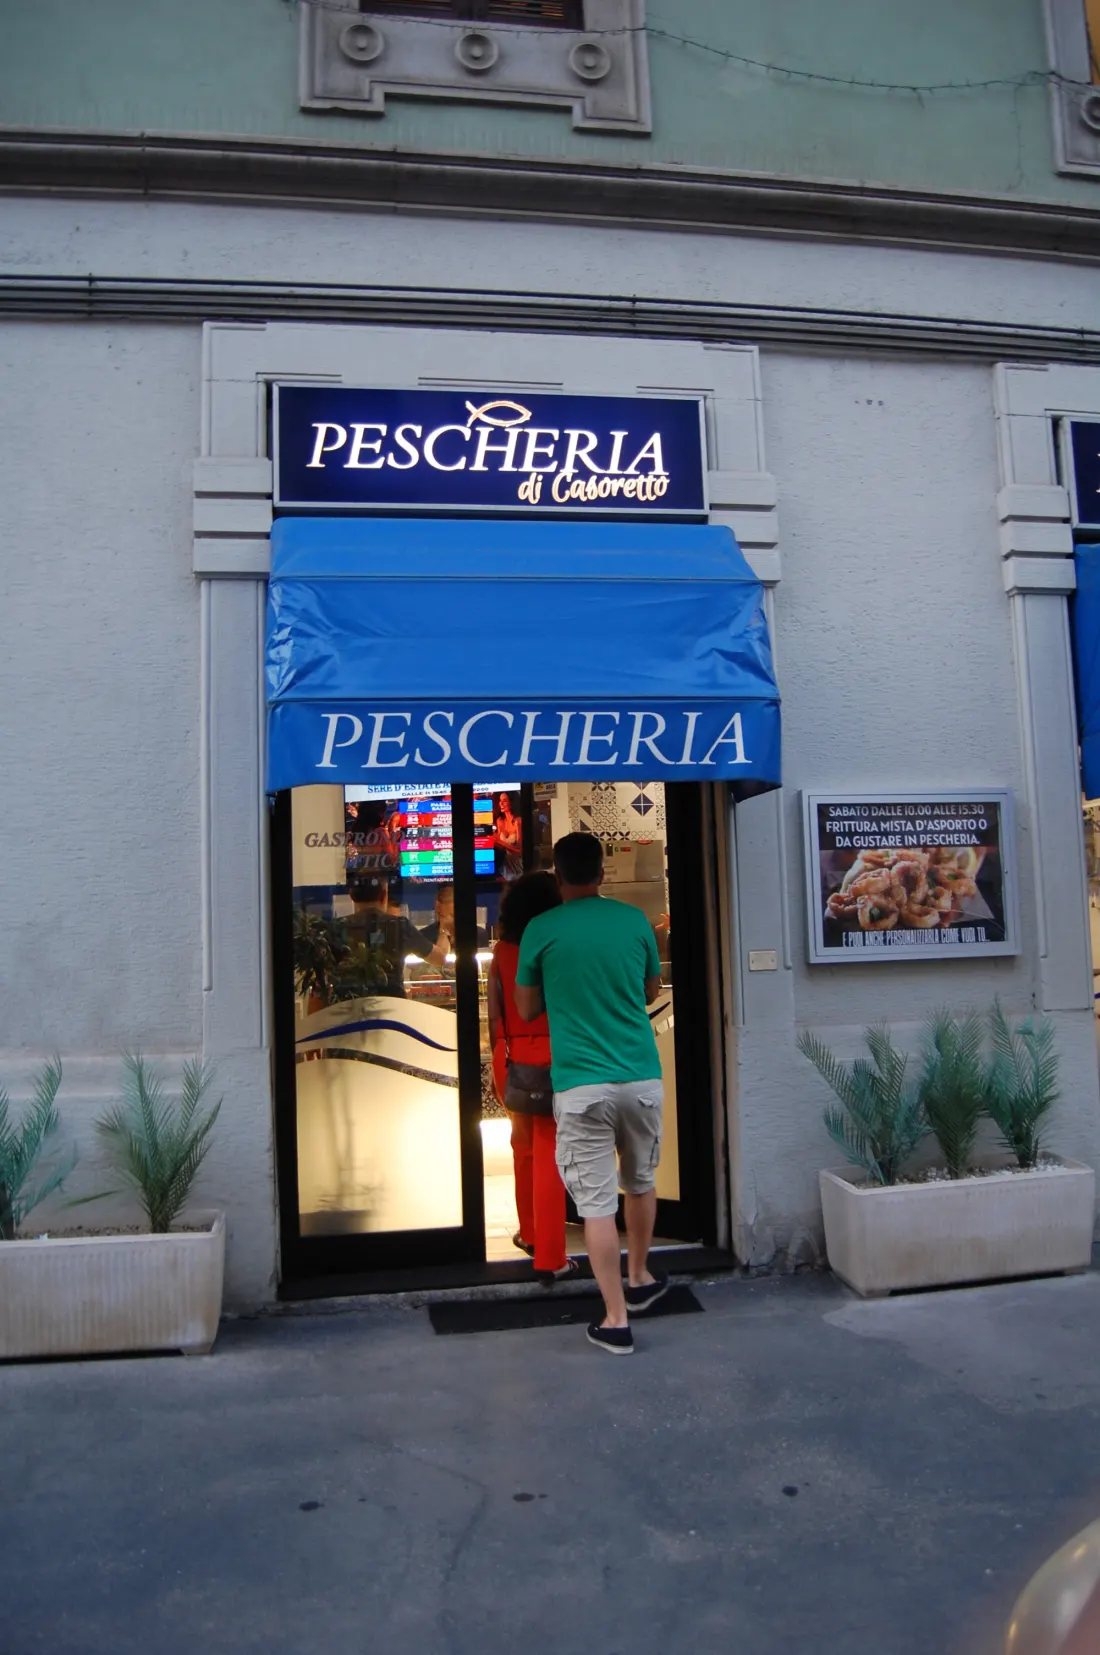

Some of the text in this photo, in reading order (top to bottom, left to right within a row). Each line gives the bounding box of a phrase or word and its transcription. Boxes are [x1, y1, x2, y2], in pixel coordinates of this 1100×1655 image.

[306, 422, 670, 475] PESCHERIA
[518, 471, 670, 504] di Casoretto
[315, 710, 753, 768] PESCHERIA
[829, 804, 985, 817] SABATO DALLE 10.00 ALLE 15.30
[826, 819, 987, 833] FRITTURA MISTA D'ASPORTO O
[835, 834, 980, 848] DA GUSTARE IN PESCHERIA.
[865, 930, 885, 946] ANCHE
[941, 927, 960, 944] COME
